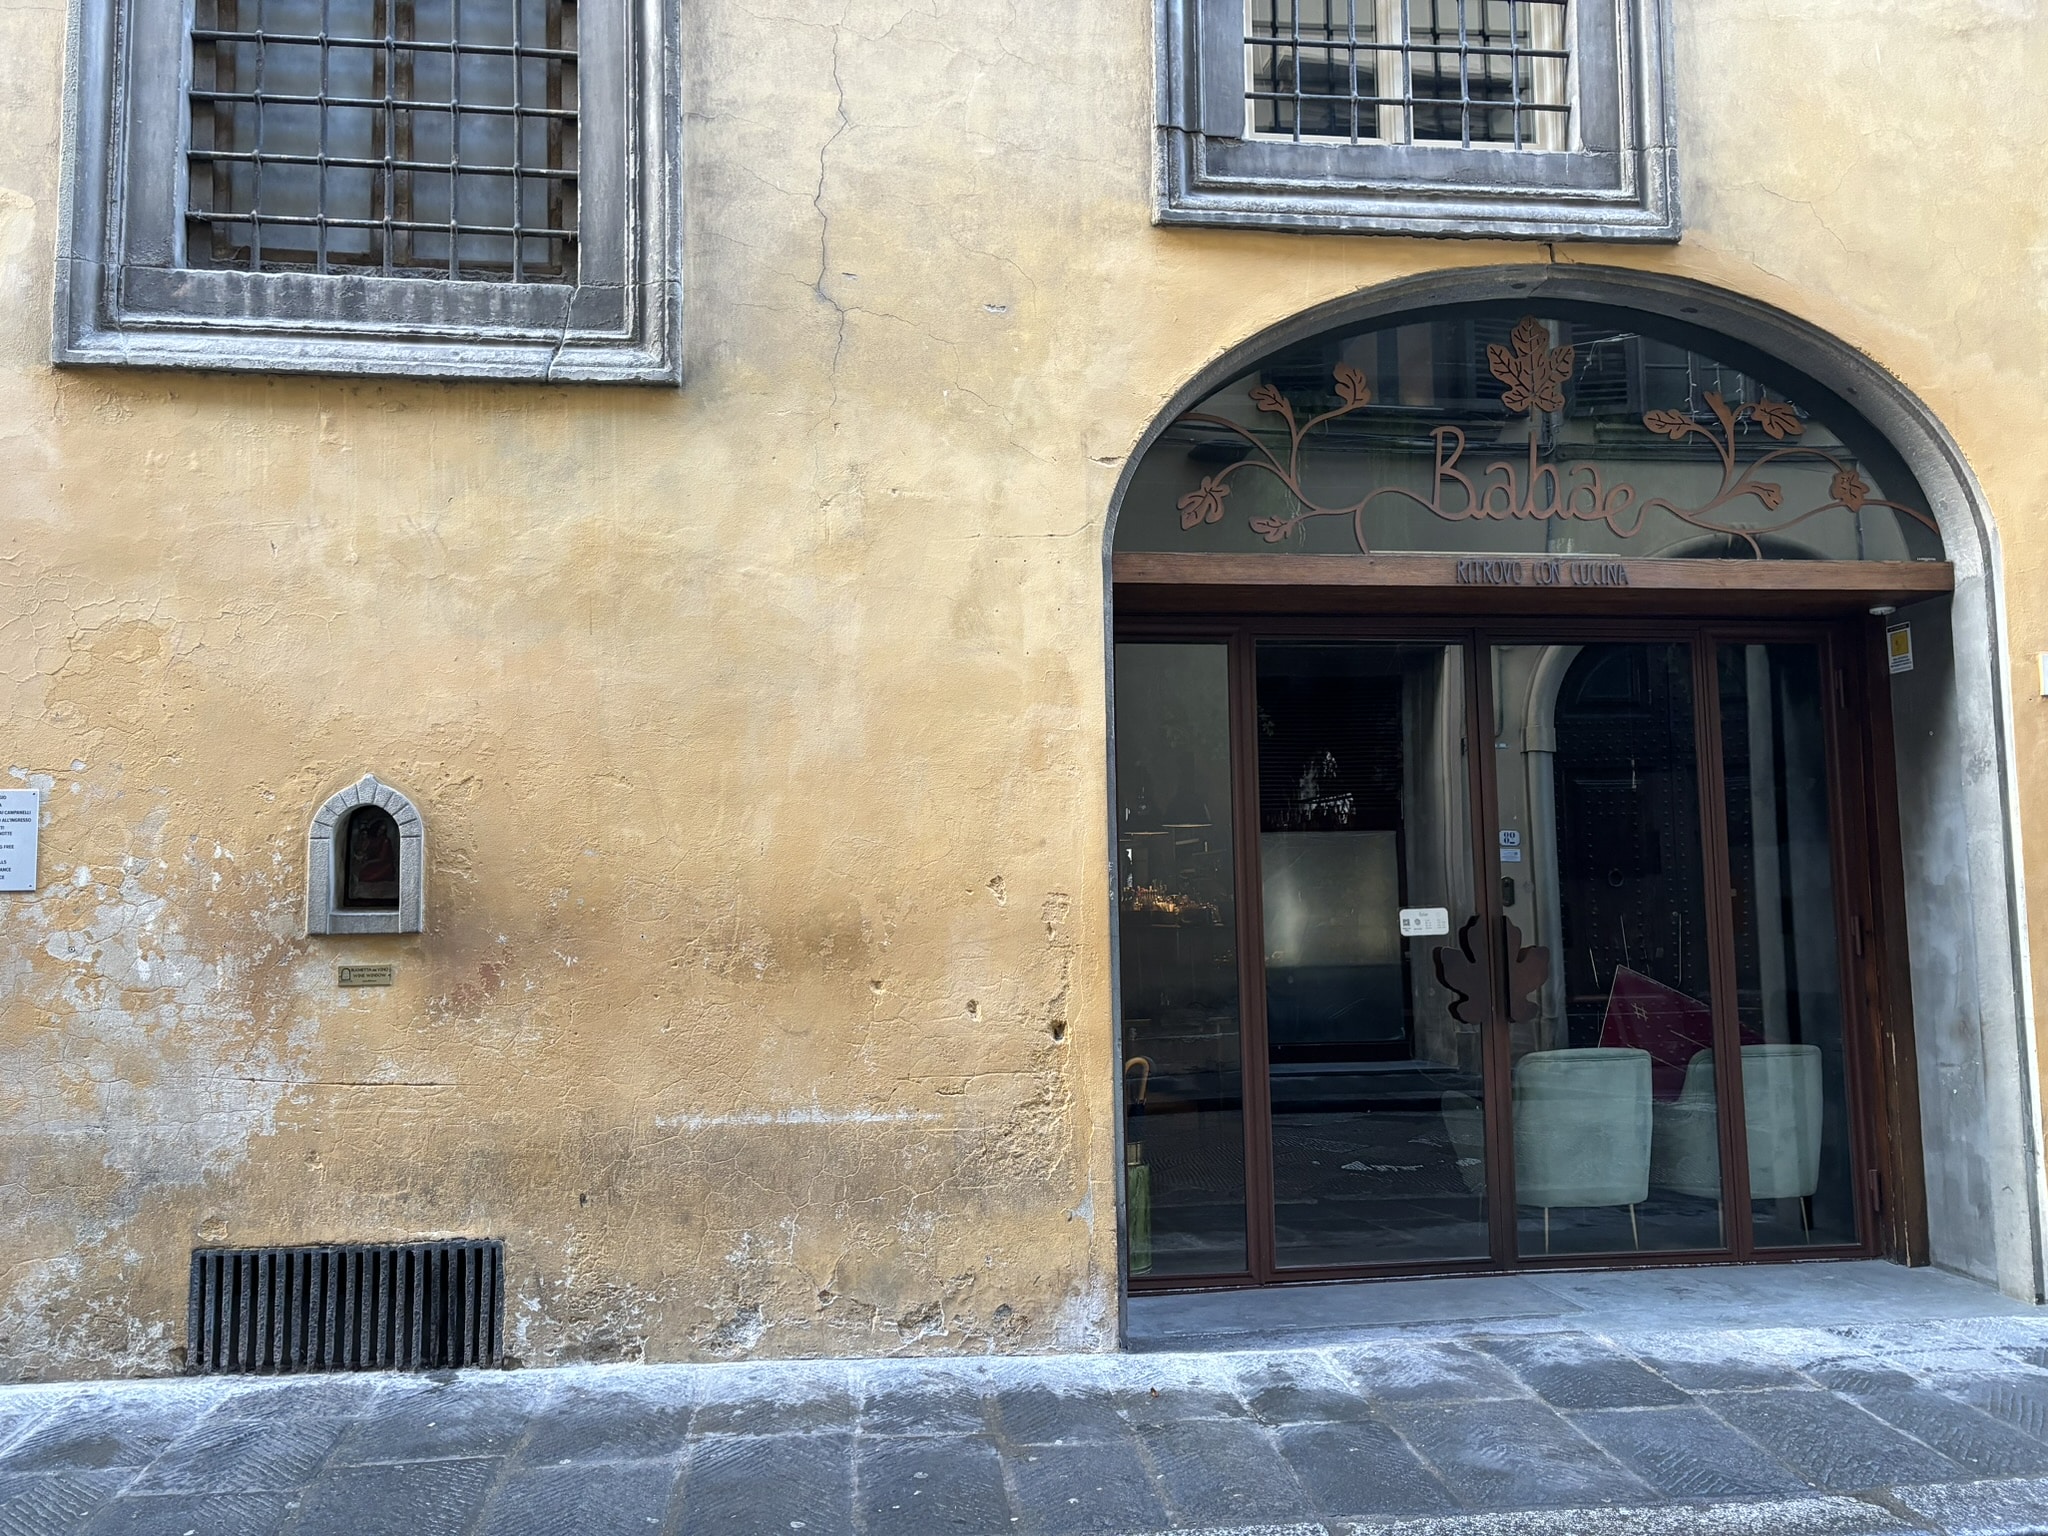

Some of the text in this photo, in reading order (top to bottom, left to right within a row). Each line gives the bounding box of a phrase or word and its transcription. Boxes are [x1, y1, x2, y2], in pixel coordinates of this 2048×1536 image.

[1430, 426, 1637, 538] Babae
[1456, 559, 1629, 586] RITROVO CON CUCINA
